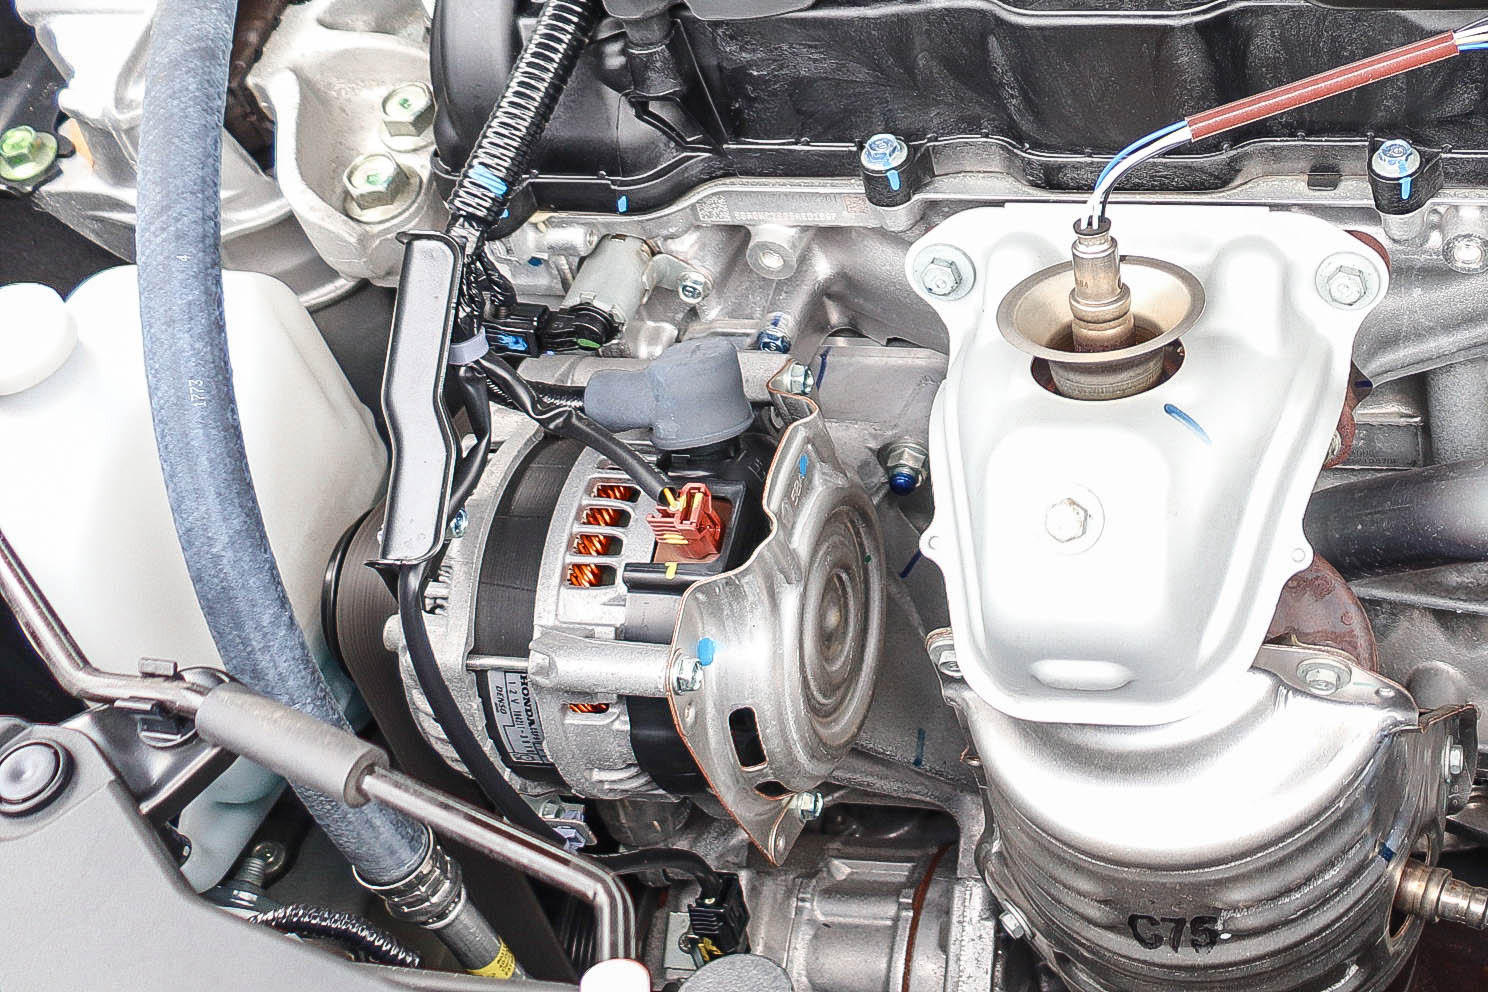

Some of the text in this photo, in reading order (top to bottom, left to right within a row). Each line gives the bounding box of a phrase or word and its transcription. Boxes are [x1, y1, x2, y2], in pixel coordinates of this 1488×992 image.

[188, 379, 207, 407] 1773
[495, 685, 508, 715] DENSO
[520, 674, 537, 727] HONDA
